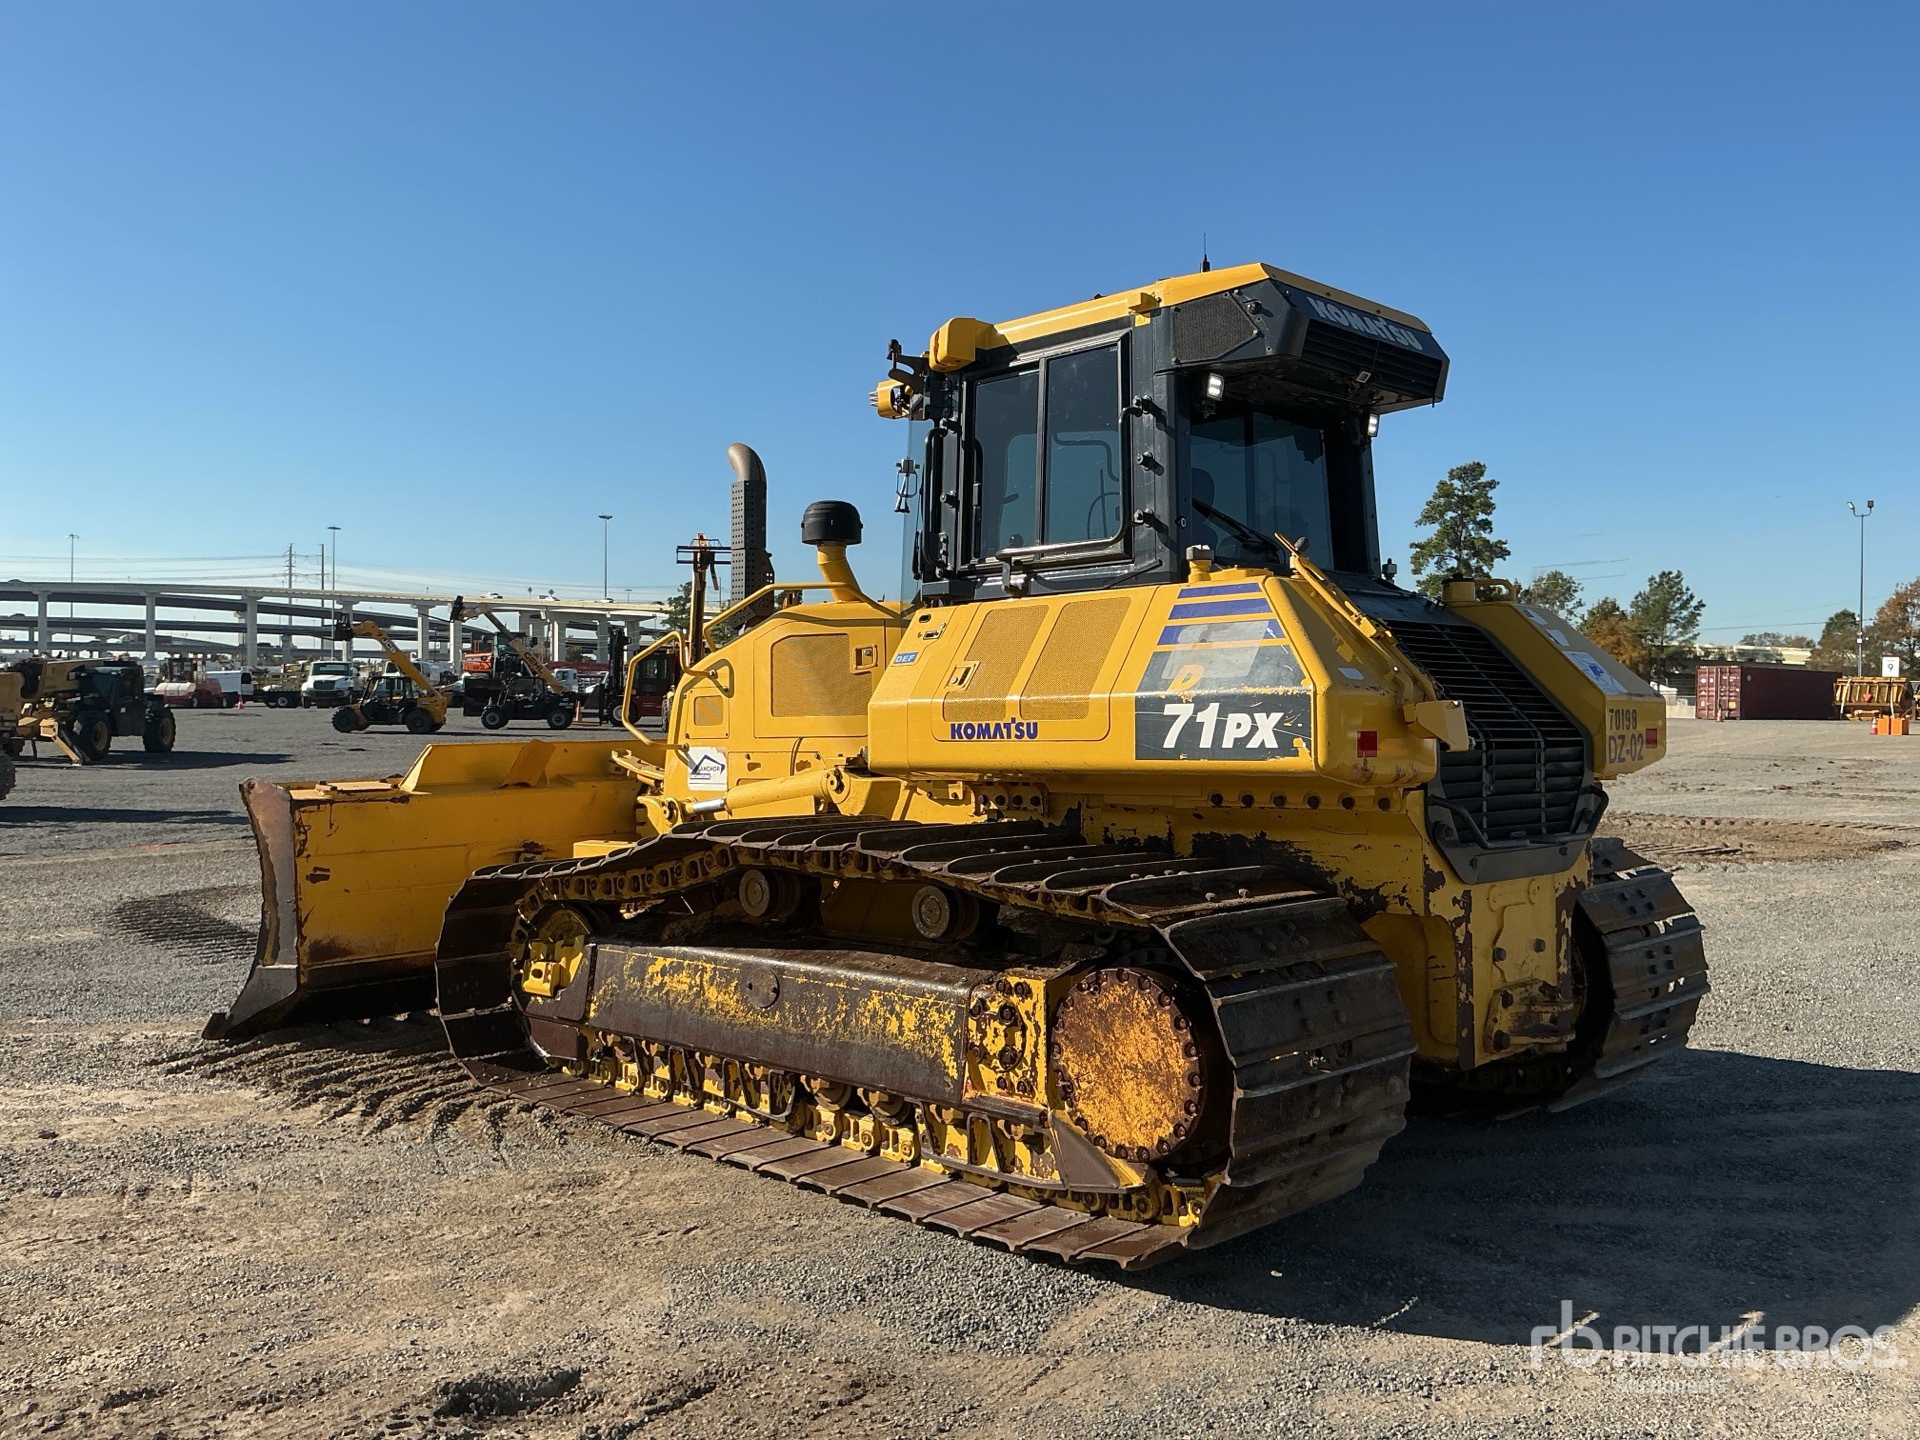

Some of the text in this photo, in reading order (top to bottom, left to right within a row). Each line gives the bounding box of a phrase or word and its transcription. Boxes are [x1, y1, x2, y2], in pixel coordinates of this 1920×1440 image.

[1307, 297, 1423, 350] KOMATSU
[524, 652, 543, 674] GEHL
[894, 654, 916, 663] DEF
[1887, 663, 1894, 672] 9
[950, 717, 1038, 740] KOMATSU
[1608, 733, 1644, 764] DZ-02
